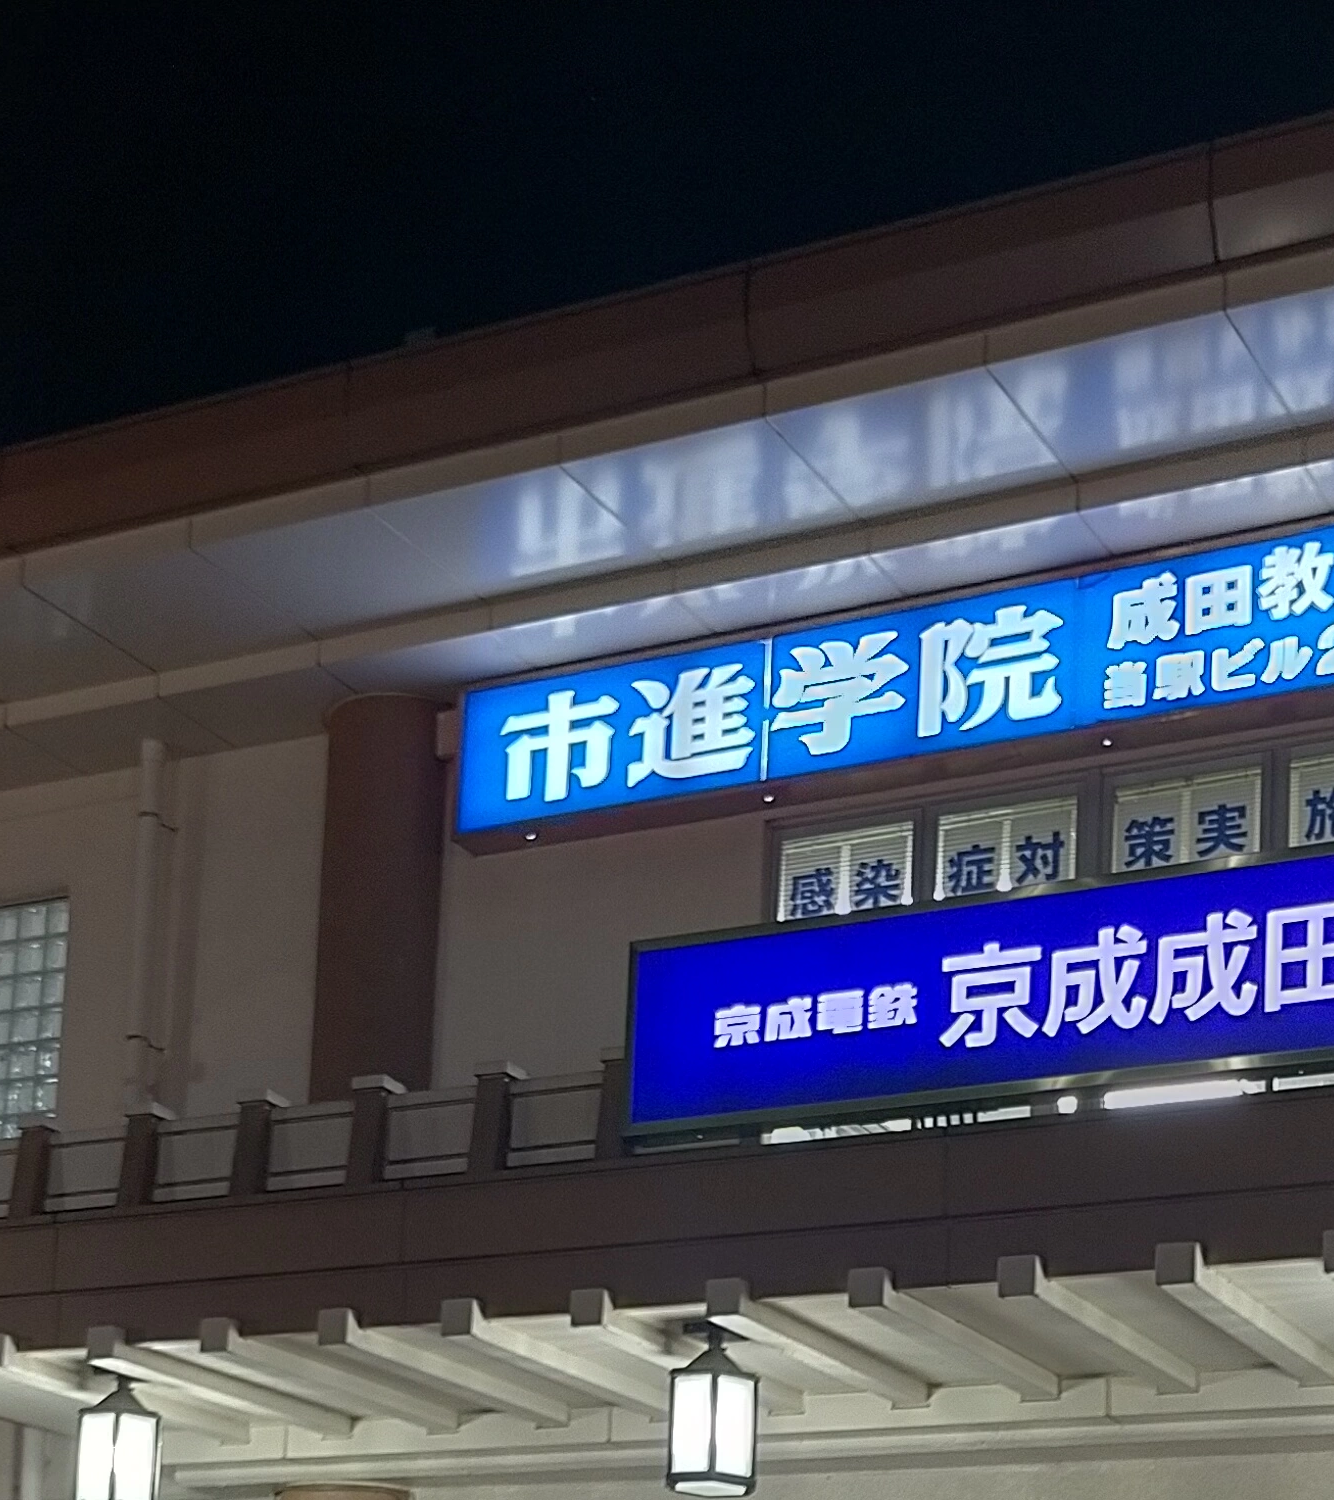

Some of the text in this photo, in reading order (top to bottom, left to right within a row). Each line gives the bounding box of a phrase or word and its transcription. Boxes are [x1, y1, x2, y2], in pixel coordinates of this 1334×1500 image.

[499, 604, 1063, 802] 市進学院
[713, 984, 919, 1048] 京成電鉄
